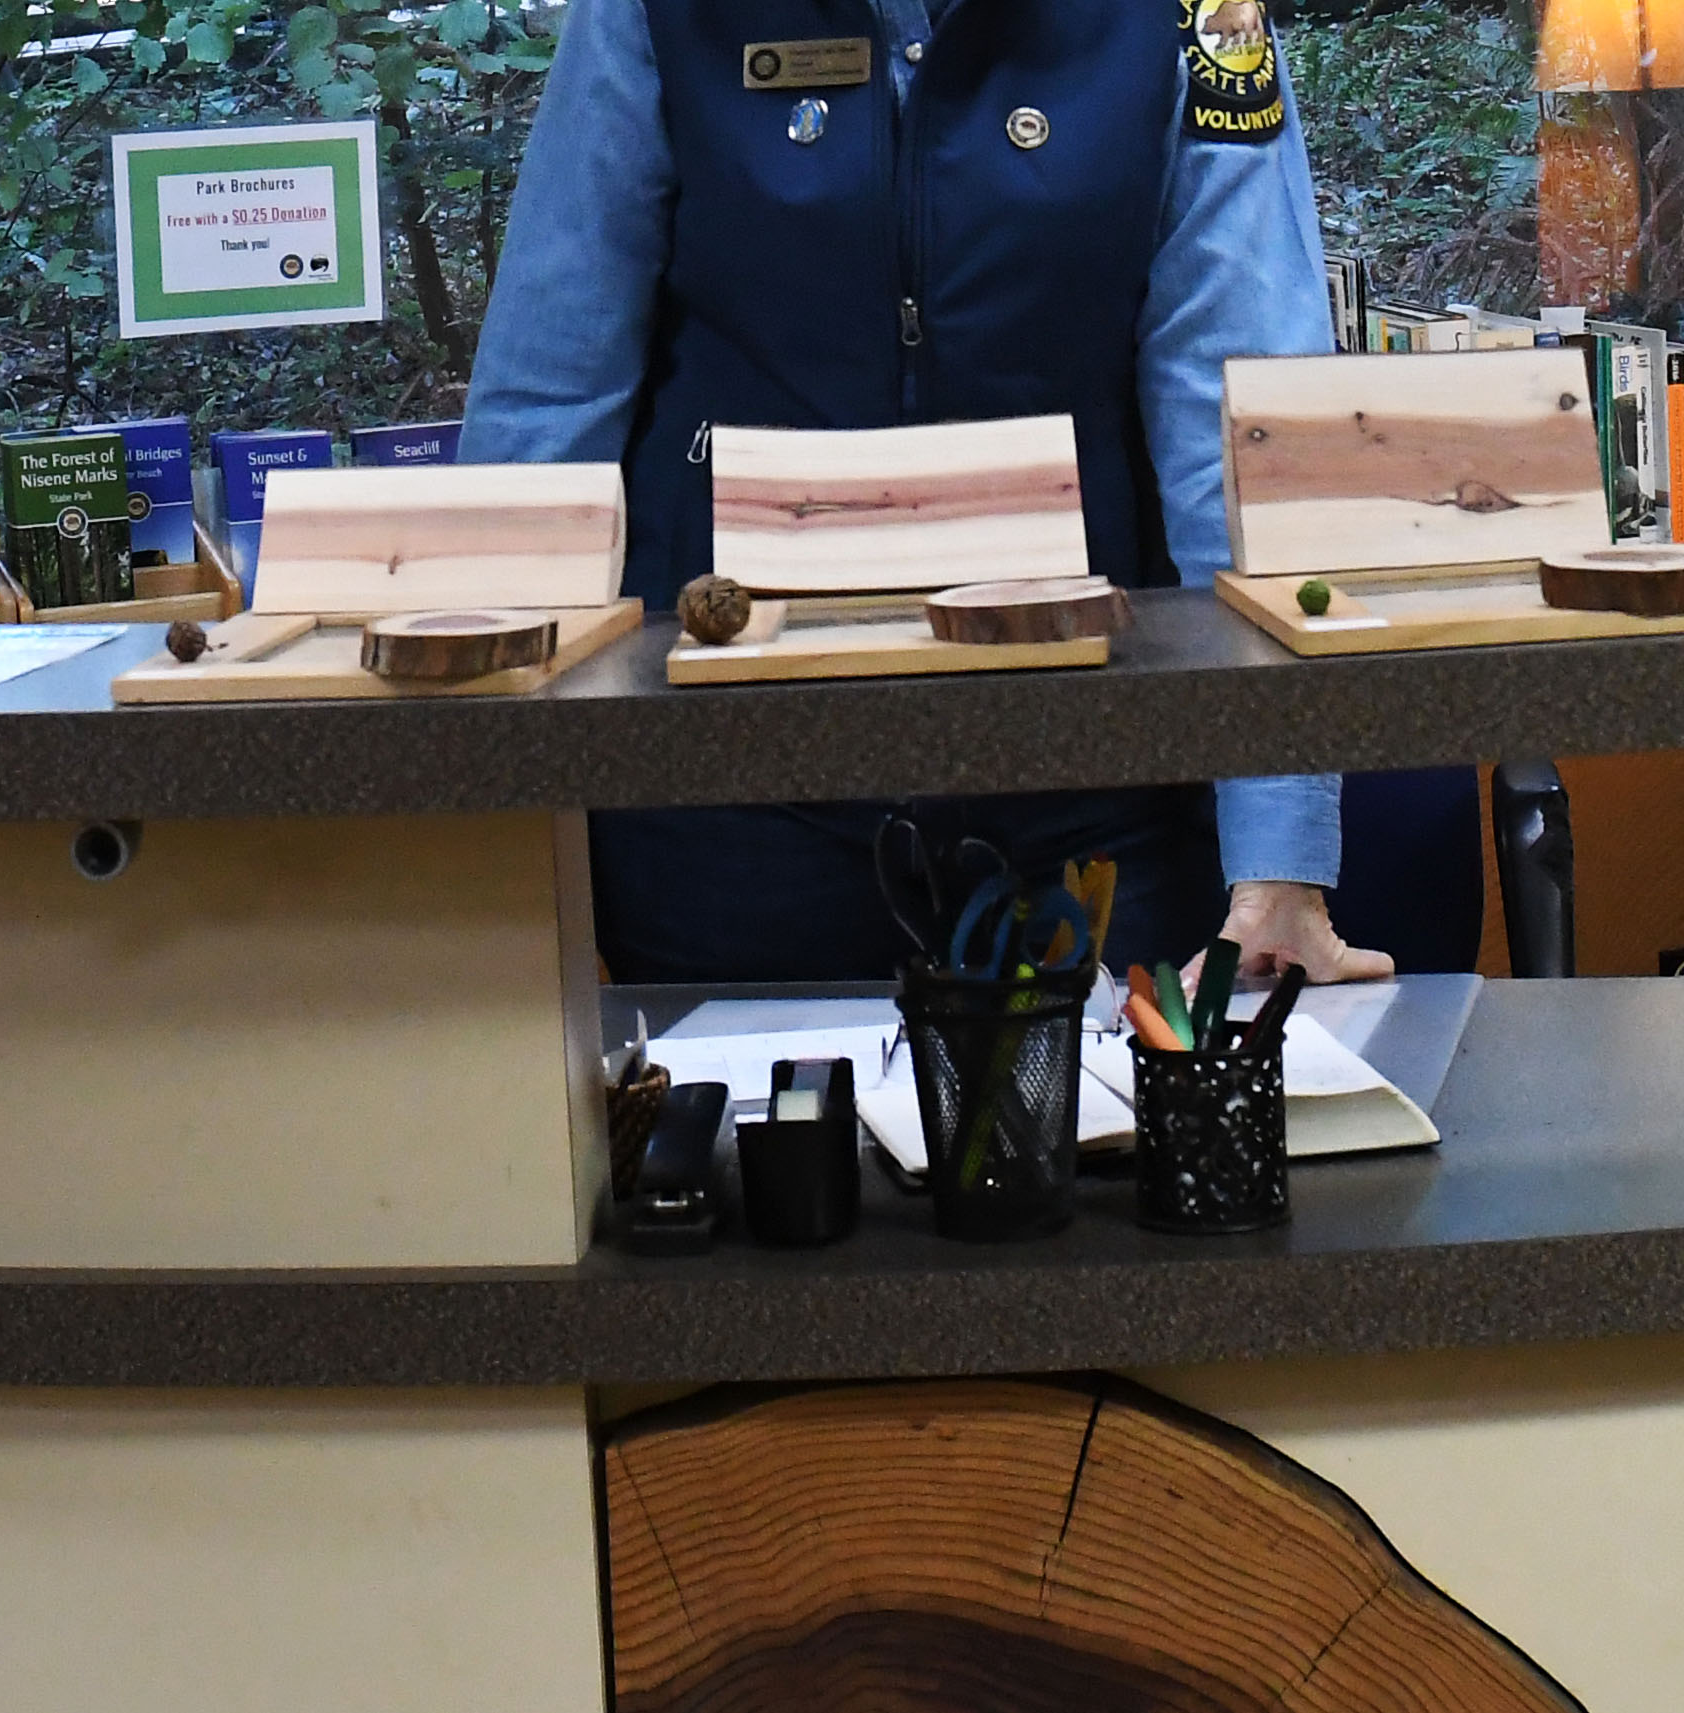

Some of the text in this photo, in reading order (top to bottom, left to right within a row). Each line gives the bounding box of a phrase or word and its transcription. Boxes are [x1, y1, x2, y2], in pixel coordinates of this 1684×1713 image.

[1185, 44, 1248, 96] STATE
[197, 177, 296, 196] Park Brochures
[167, 213, 192, 227] Free
[195, 213, 218, 226] with
[222, 215, 229, 224] a
[271, 206, 328, 223] Donation
[221, 238, 249, 252] Thank
[1618, 354, 1630, 393] Birds
[20, 454, 48, 470] The
[51, 451, 96, 468] Forest
[100, 446, 115, 464] of
[135, 446, 183, 463] Bridges
[247, 448, 308, 466] Sunset &
[393, 439, 441, 458] Seacliff
[20, 466, 118, 489] Nisene Marks
[48, 490, 93, 504] State Park
